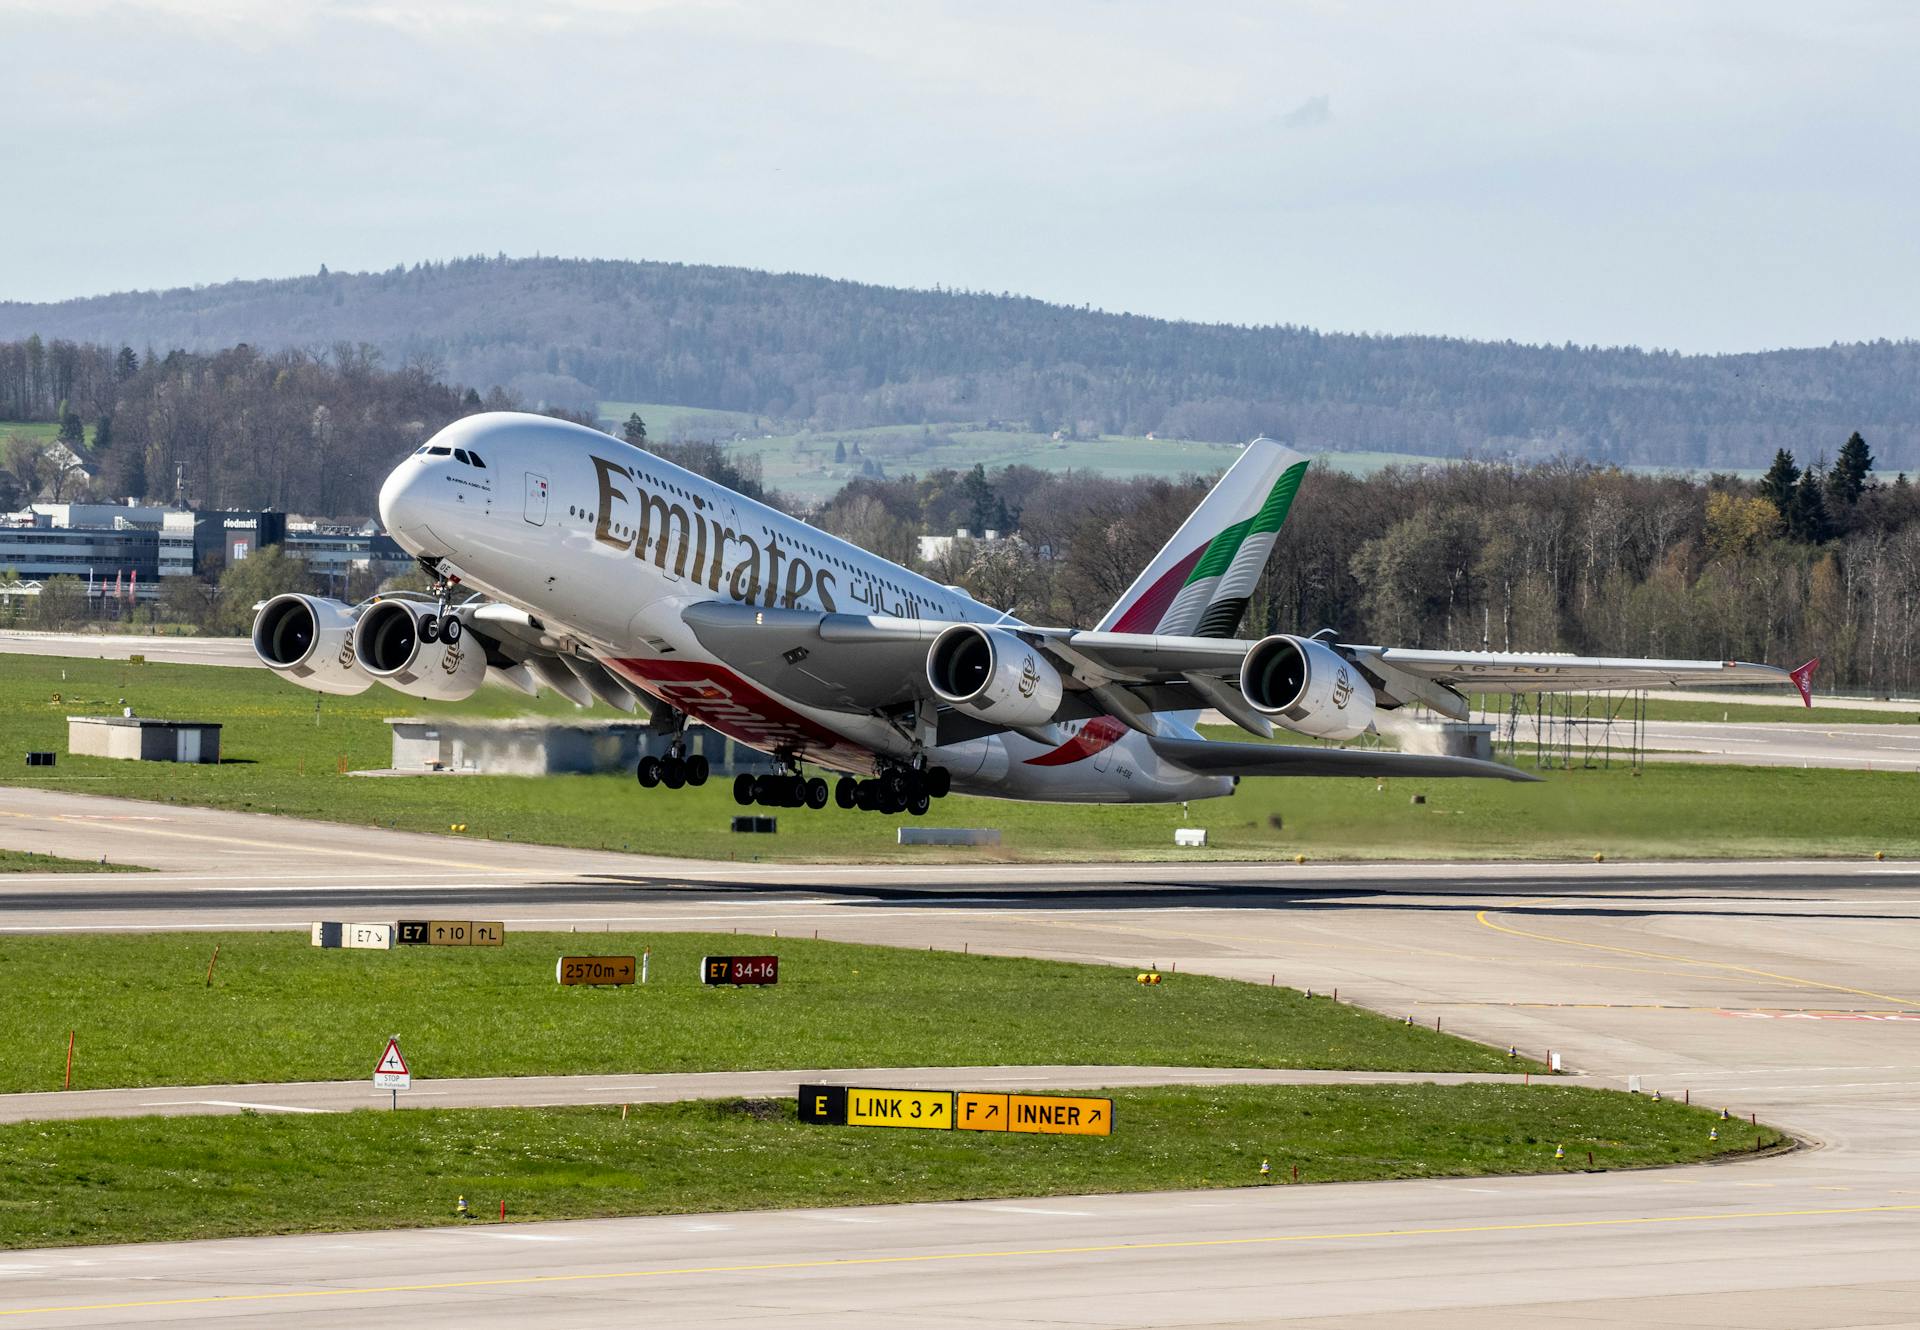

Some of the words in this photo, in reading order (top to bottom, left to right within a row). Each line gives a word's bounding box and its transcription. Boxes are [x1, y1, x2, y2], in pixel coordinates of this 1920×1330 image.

[589, 455, 836, 613] Emirates
[1451, 664, 1571, 674] A6-EOE
[358, 930, 371, 942] E7
[403, 926, 423, 939] E7
[450, 927, 464, 939] 10
[489, 927, 497, 940] L
[566, 964, 615, 978] 2570m
[711, 963, 728, 977] E7
[735, 963, 775, 978] 34-16
[384, 1074, 400, 1082] STOP
[815, 1096, 827, 1116] E
[856, 1098, 902, 1118] LINK
[910, 1101, 922, 1119] 3
[966, 1102, 978, 1121] F
[1017, 1104, 1081, 1126] INNER
